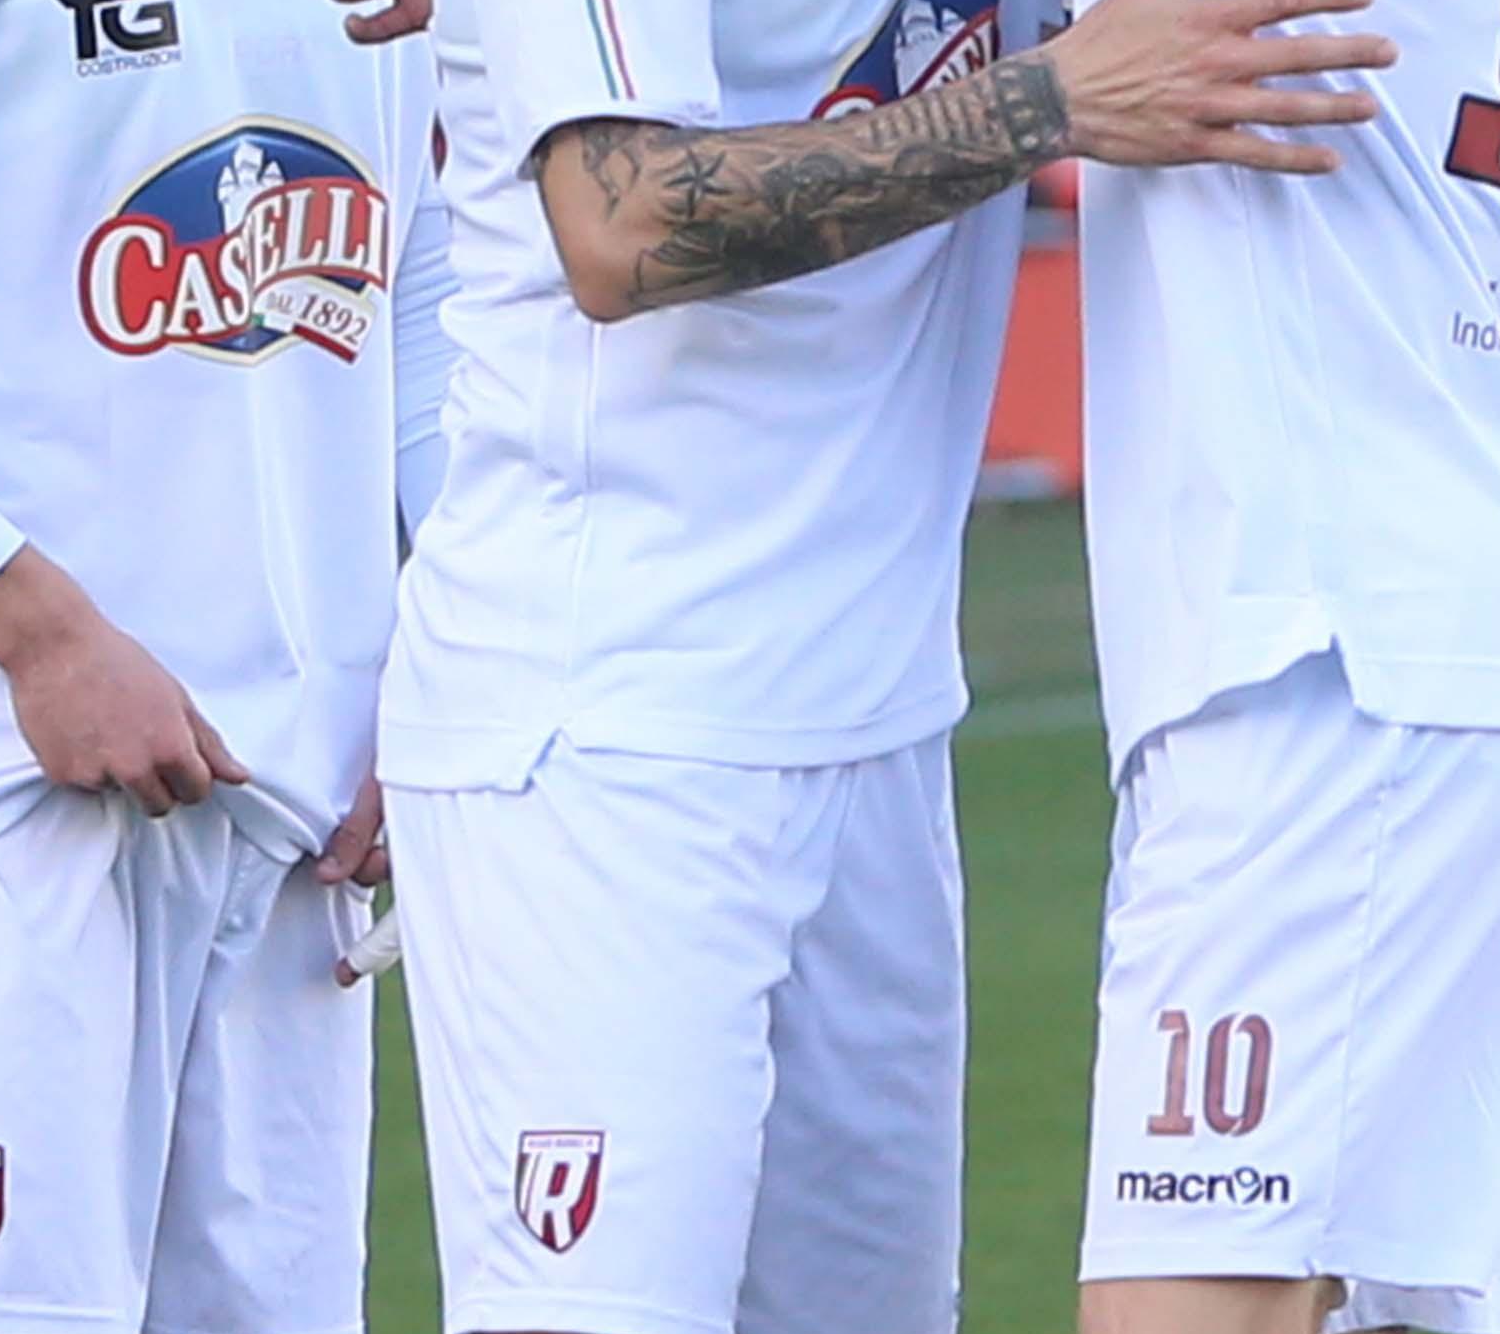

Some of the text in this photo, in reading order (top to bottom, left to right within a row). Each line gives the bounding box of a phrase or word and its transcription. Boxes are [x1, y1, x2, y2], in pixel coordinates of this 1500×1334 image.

[301, 293, 367, 346] 1892
[1146, 1009, 1272, 1138] 10
[1117, 1166, 1291, 1205] macron
